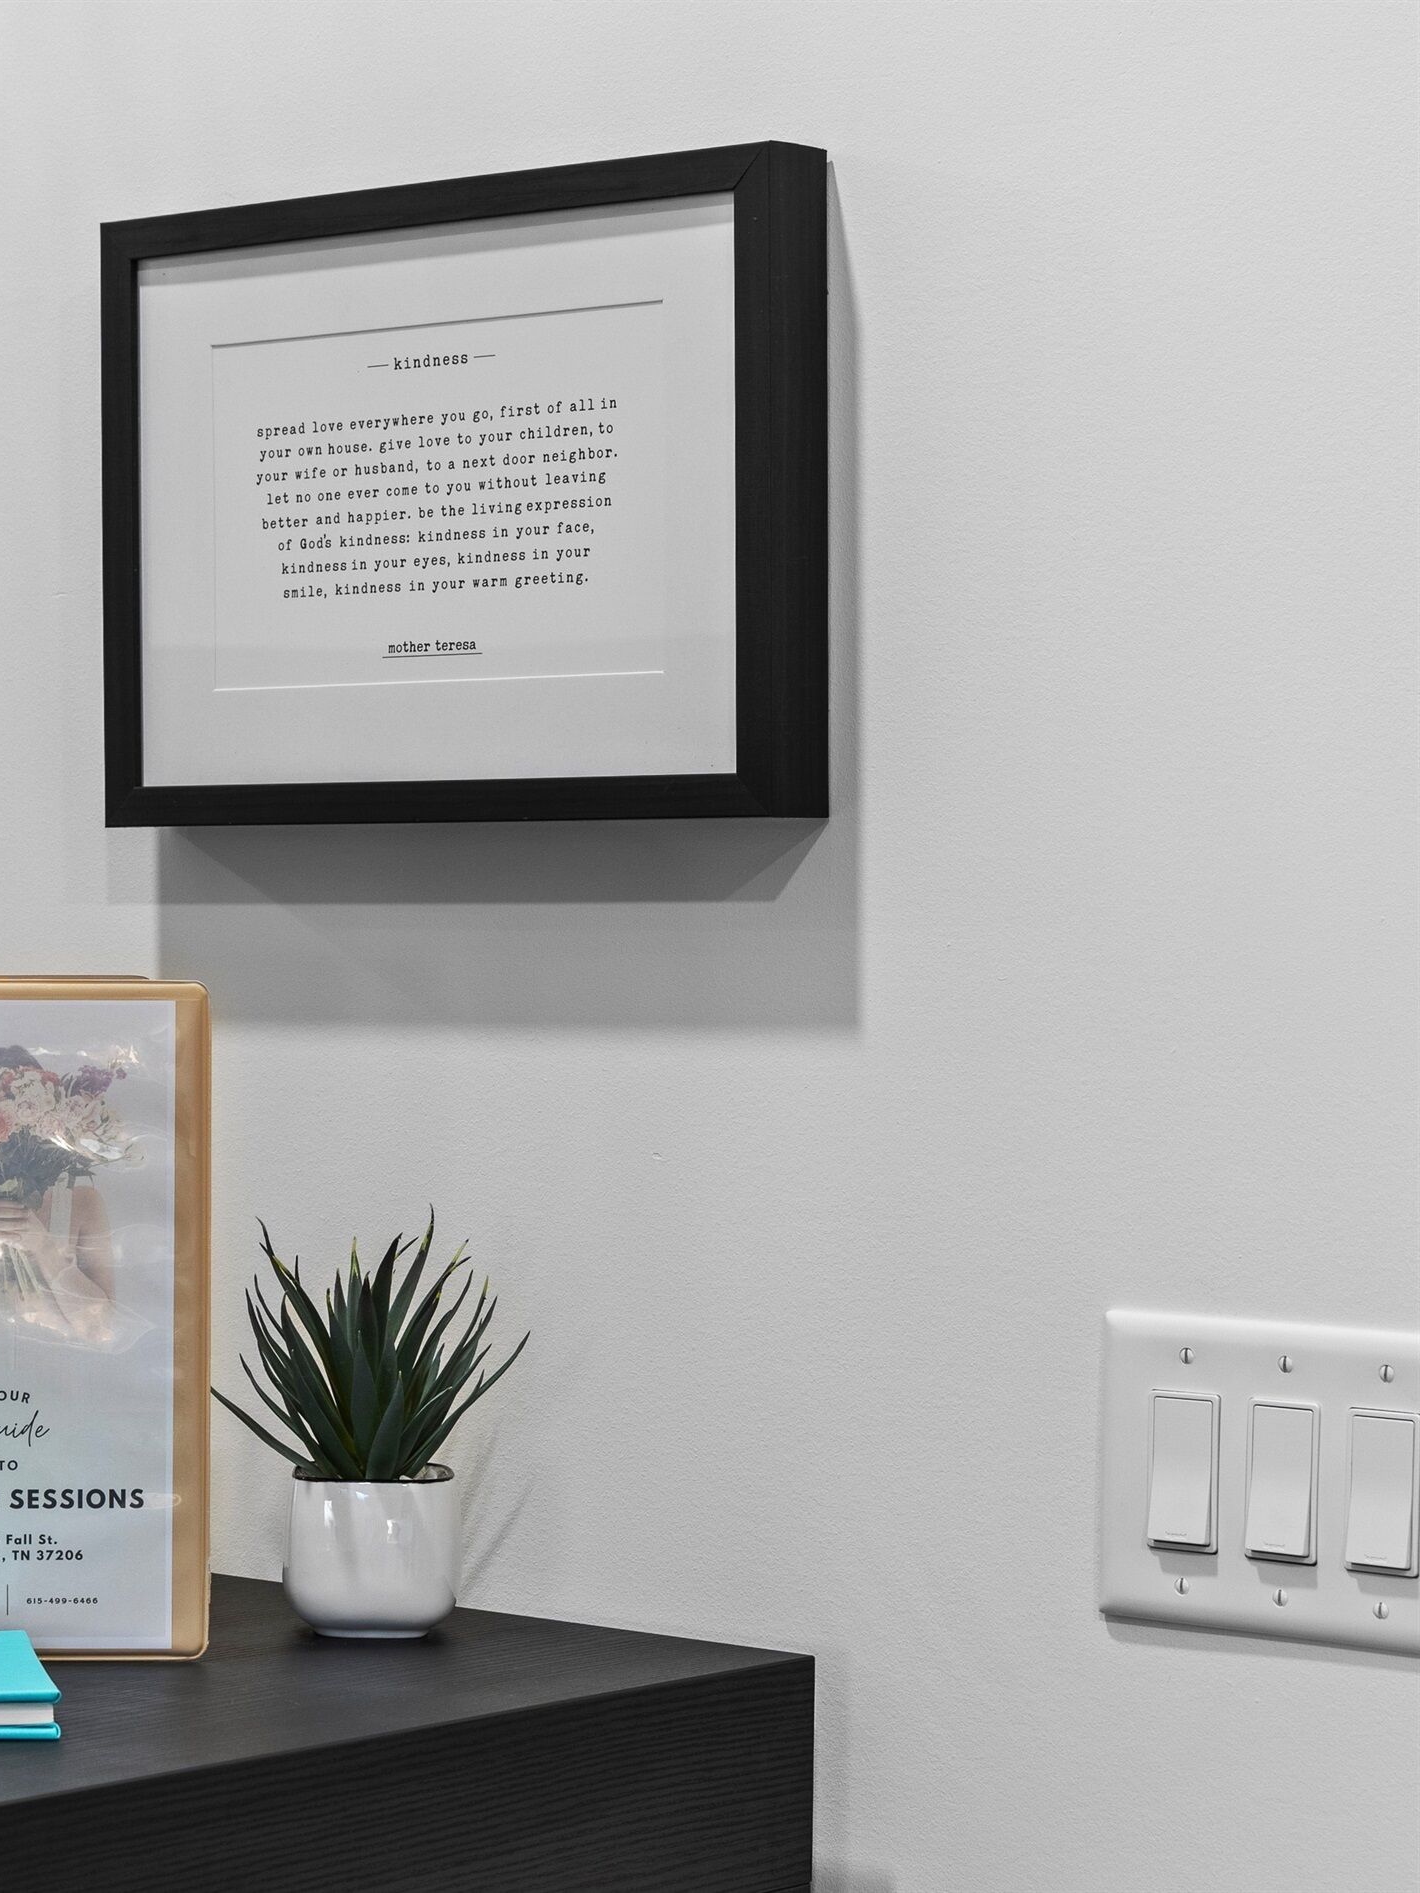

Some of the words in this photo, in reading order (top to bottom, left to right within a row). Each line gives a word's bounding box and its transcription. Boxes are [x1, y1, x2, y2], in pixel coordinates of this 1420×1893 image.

[393, 353, 469, 371] kindness
[256, 421, 306, 441] spread
[311, 420, 344, 434] love
[349, 413, 435, 432] everywhere
[440, 411, 466, 427] you
[471, 409, 494, 424] go,
[499, 402, 541, 419] first
[546, 400, 563, 415] of
[568, 397, 596, 413] all
[600, 396, 618, 411] in
[258, 447, 293, 463] your
[297, 445, 323, 457] own
[327, 442, 373, 456] house.
[378, 438, 412, 455] give
[417, 435, 451, 449] love
[456, 432, 473, 446] to
[478, 431, 514, 447] your
[518, 424, 594, 441] children,
[597, 421, 614, 435] to
[255, 471, 289, 487] your
[294, 466, 327, 481] wife
[332, 466, 349, 478] or
[354, 459, 419, 477] husband,
[425, 458, 442, 472] to
[447, 459, 456, 471] a
[462, 453, 497, 470] next
[501, 452, 536, 467] door
[542, 446, 618, 465] neighbor.
[266, 491, 290, 506] let
[295, 492, 312, 504] no
[316, 490, 342, 503] one
[347, 488, 380, 501] ever
[385, 485, 419, 498] come
[424, 481, 440, 495] to
[445, 481, 472, 497] you
[477, 474, 538, 491] without
[544, 470, 607, 486] leaving
[261, 516, 309, 531] better
[315, 511, 341, 526] and
[346, 508, 412, 526] happier.
[417, 506, 435, 520] be
[440, 504, 466, 518] the
[471, 501, 523, 516] living
[525, 495, 613, 515] expression
[277, 538, 293, 552] of
[299, 532, 333, 551] God's
[339, 533, 411, 548] kindness:
[417, 528, 487, 544] kindness
[492, 525, 509, 539] in
[515, 524, 551, 541] your
[556, 520, 595, 536] face,
[281, 560, 348, 576] kindness
[351, 558, 368, 572] in
[373, 557, 408, 573] your
[412, 555, 451, 570] eyes,
[456, 549, 527, 565] kindness
[532, 547, 550, 561] in
[555, 546, 592, 563] your
[282, 584, 328, 600] smile,
[334, 581, 402, 596] kindness
[408, 579, 426, 593] in
[431, 579, 466, 594] your
[471, 576, 508, 589] warm
[513, 571, 589, 590] greeting.
[387, 640, 432, 655] mother
[434, 639, 477, 652] teresa
[8, 1487, 145, 1510] SESSIONS
[5, 1533, 33, 1546] Fall
[37, 1533, 58, 1546] St.
[11, 1549, 31, 1562] TN
[35, 1549, 84, 1562] 37206
[25, 1596, 99, 1605] 615-499-6466
